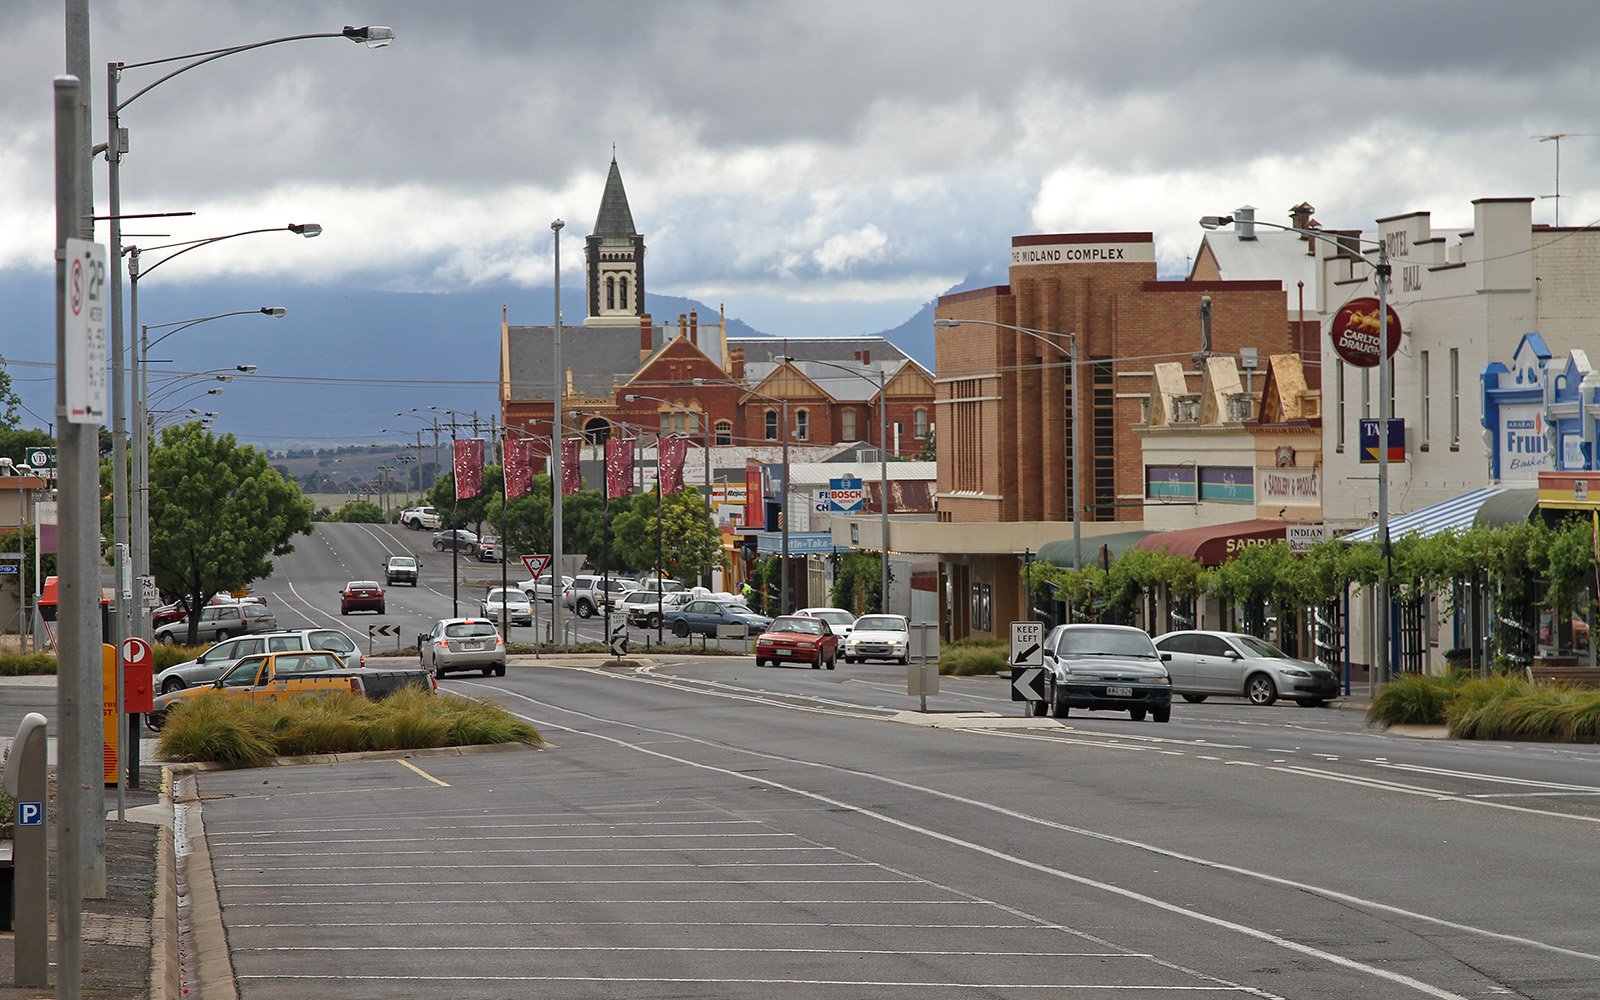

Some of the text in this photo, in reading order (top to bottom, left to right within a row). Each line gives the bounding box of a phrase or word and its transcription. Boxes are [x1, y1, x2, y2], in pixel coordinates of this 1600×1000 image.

[1387, 231, 1408, 258] HOTEL
[1022, 250, 1061, 262] MIDLAND
[1067, 249, 1124, 260] COMPLEX
[89, 260, 105, 301] 2P
[1403, 265, 1421, 292] HALL
[1343, 329, 1380, 346] CARLTO
[1338, 336, 1380, 356] DRAUGH
[1507, 431, 1548, 453] Fruit
[33, 455, 45, 463] VB
[1510, 455, 1547, 469] Basket
[831, 491, 862, 499] BOSCH
[1291, 529, 1323, 537] INDIAN
[1016, 626, 1039, 634] KEEP
[1017, 635, 1038, 643] LEFT
[23, 804, 38, 823] P
